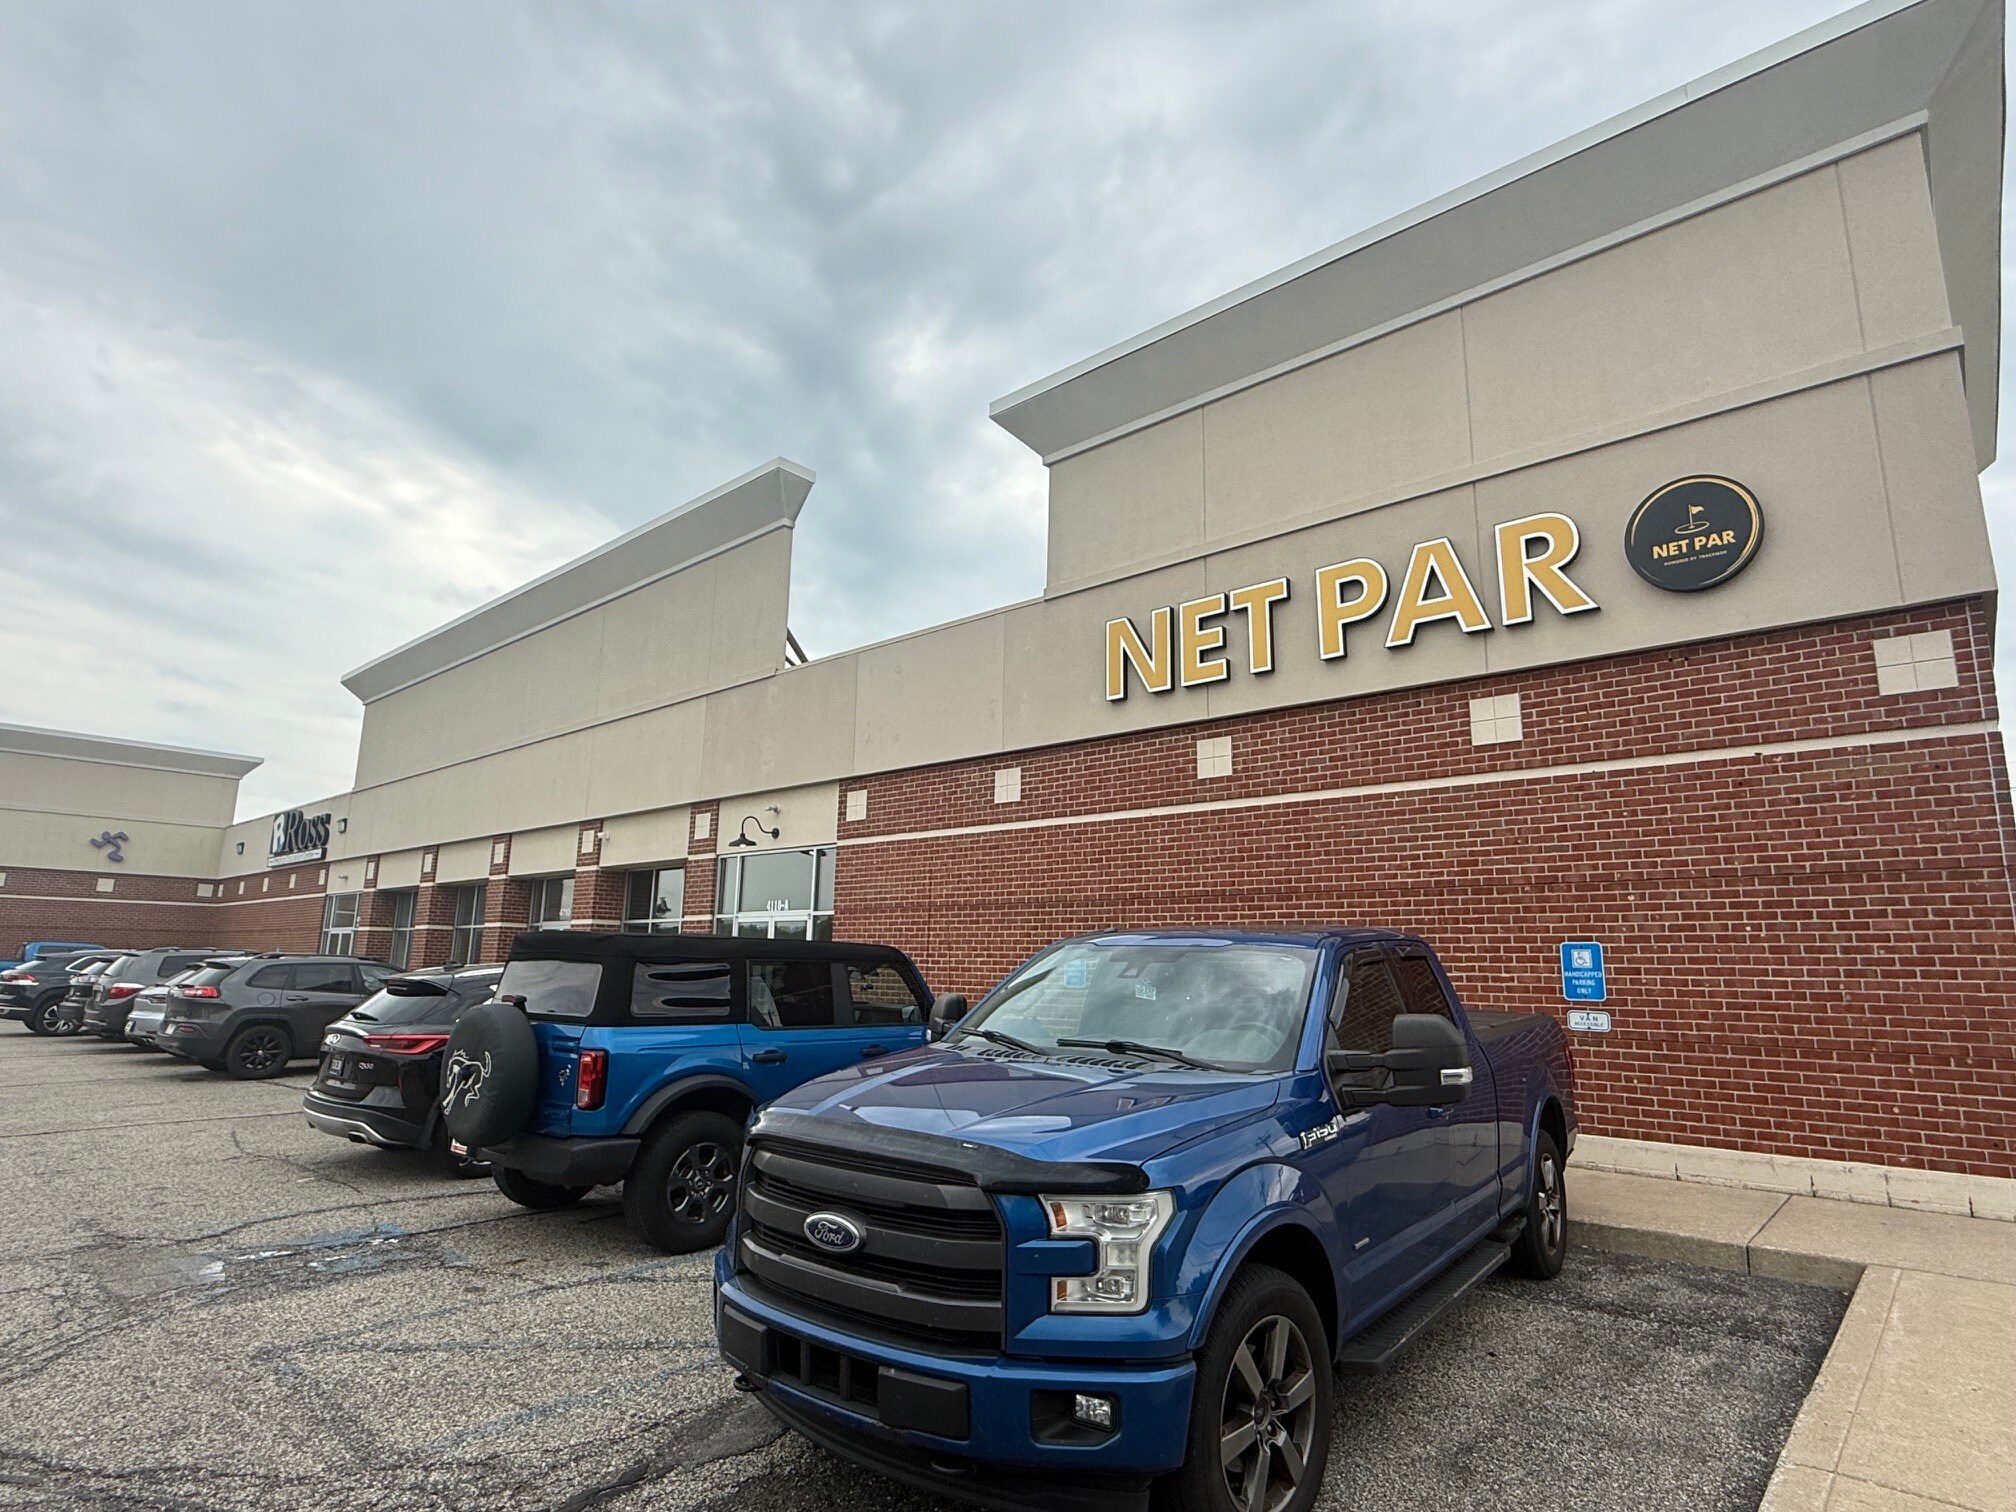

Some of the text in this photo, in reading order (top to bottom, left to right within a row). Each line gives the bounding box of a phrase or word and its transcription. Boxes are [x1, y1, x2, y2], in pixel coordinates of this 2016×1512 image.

[1652, 530, 1736, 559] NET PAR
[1664, 557, 1689, 566] POWERED
[1106, 512, 1600, 702] NET PAR
[1579, 1014, 1598, 1022] VAN
[814, 1221, 845, 1244] Ford
